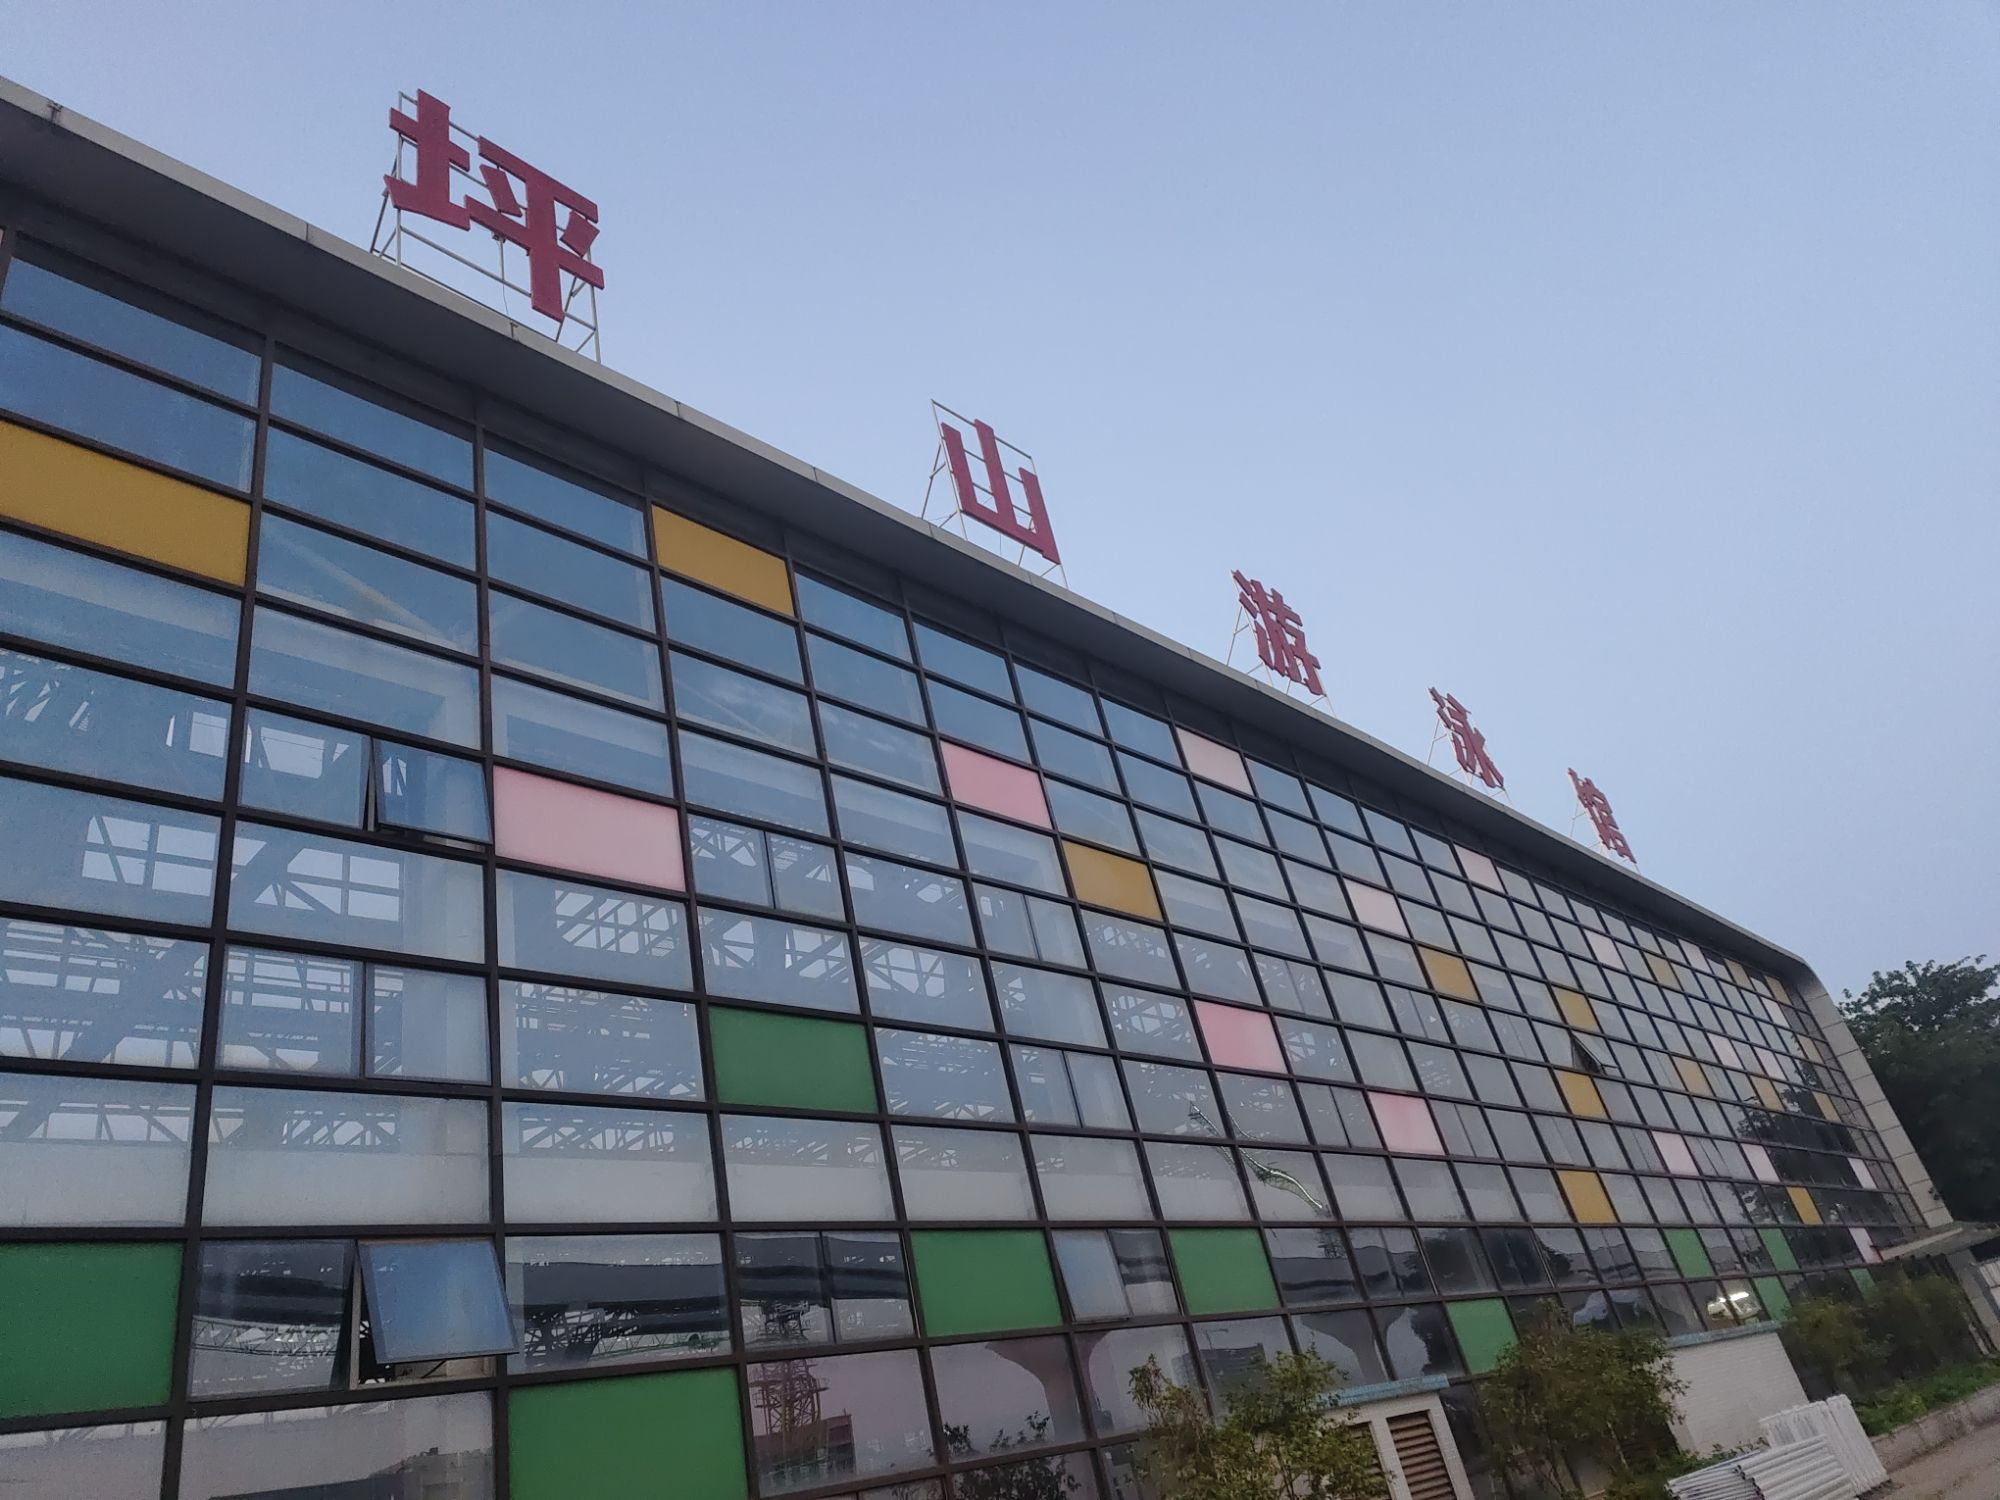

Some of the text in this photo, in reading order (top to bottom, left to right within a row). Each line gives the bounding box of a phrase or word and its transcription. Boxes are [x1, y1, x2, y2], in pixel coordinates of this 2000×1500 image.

[384, 88, 1637, 864] 坪山游泳馆
